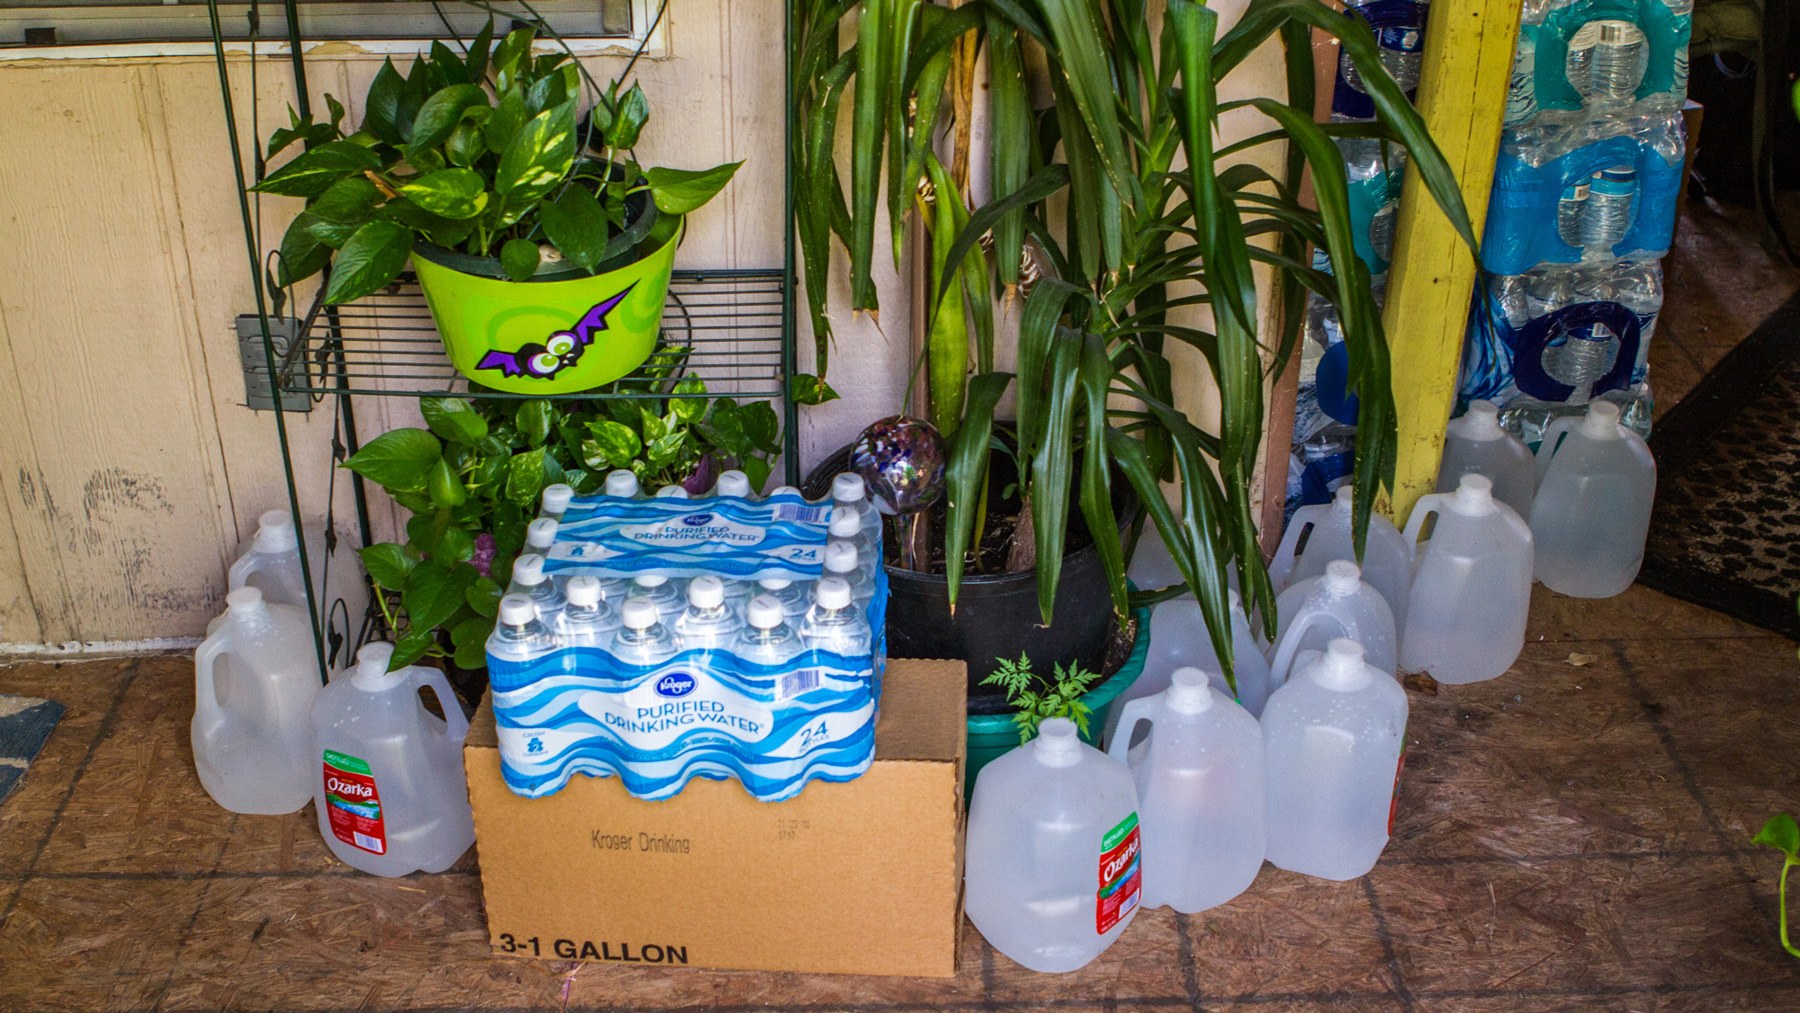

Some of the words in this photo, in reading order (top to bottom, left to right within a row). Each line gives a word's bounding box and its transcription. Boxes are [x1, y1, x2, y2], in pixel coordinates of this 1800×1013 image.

[634, 532, 707, 540] DRINKING
[708, 533, 756, 541] WATER
[791, 548, 817, 558] 24
[660, 676, 693, 694] Kroger
[637, 700, 725, 719] PURIFIED
[604, 711, 695, 733] DRINKING
[697, 713, 760, 735] WATER
[800, 720, 828, 747] 24
[327, 777, 373, 797] Ozarka
[591, 829, 633, 851] Kroger
[638, 831, 690, 855] Drinking
[1103, 837, 1139, 882] Ozarka
[499, 933, 541, 957] 3-1
[553, 938, 689, 964] GALLON
